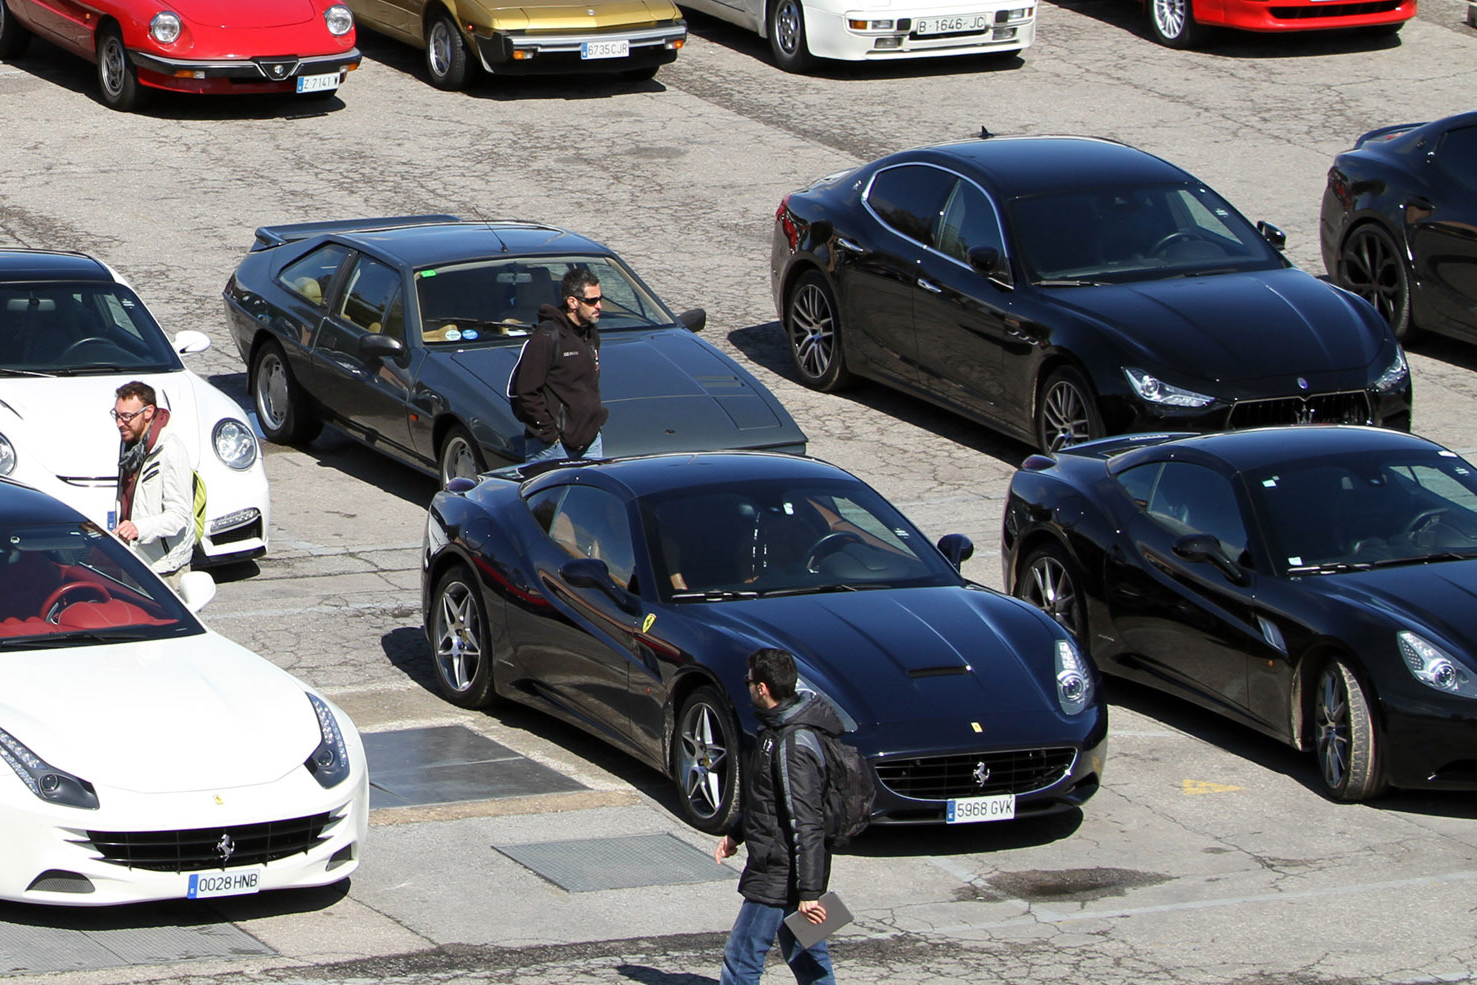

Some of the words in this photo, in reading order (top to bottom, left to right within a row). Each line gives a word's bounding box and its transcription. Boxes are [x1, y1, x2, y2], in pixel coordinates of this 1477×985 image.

[935, 18, 963, 32] 1646
[588, 44, 611, 56] 6735
[611, 43, 628, 55] CJR
[312, 77, 331, 88] 7141
[956, 801, 988, 818] 5968
[990, 799, 1013, 815] GVK
[198, 877, 232, 892] 0028
[233, 873, 259, 889] HNB
